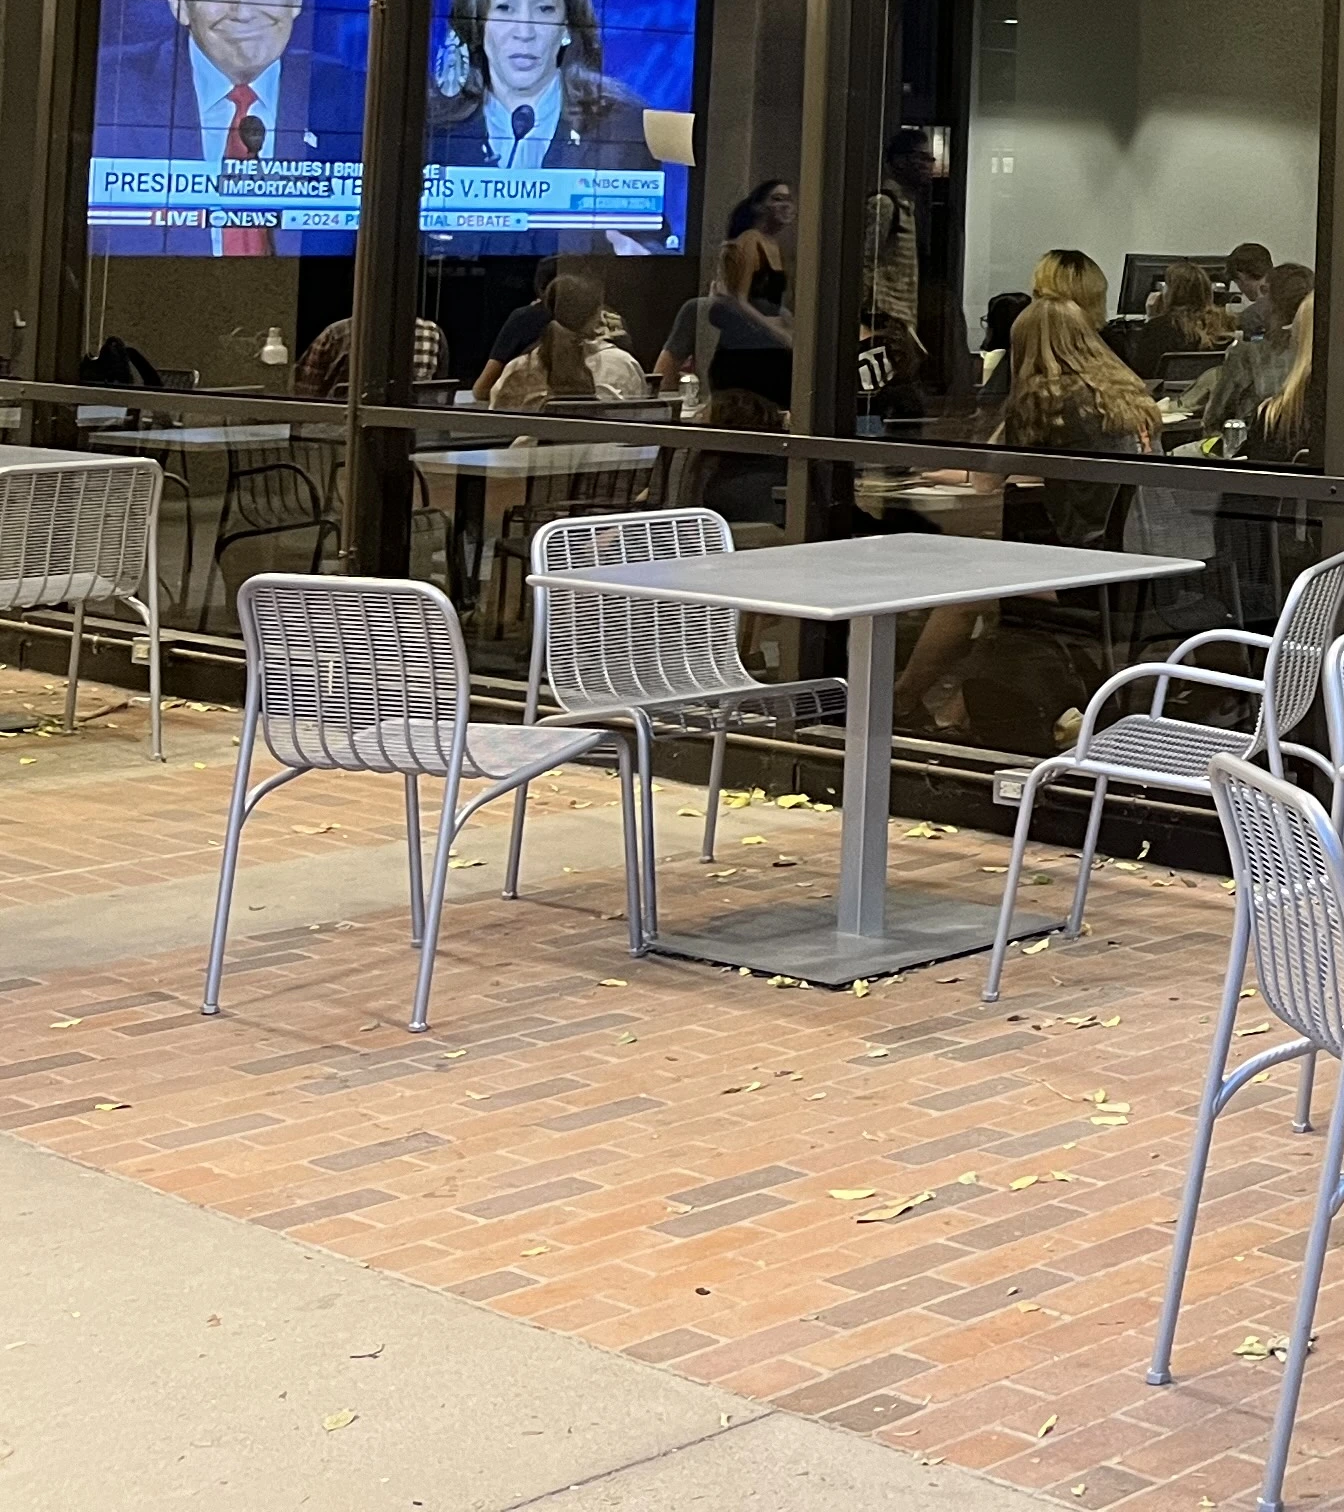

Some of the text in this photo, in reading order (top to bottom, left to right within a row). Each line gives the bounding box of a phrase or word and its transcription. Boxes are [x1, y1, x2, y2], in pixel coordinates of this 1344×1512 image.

[224, 159, 257, 175] THE
[262, 160, 322, 176] VALUES
[325, 161, 331, 177] I
[333, 161, 364, 177] BRI
[104, 171, 220, 194] PRESIDEN
[223, 179, 330, 196] IMPORTANCE
[592, 178, 660, 190] NBC NEWS
[155, 210, 199, 226] LIVE
[226, 211, 278, 227] NEWS
[302, 213, 340, 226] 2024
[456, 215, 511, 227] DEBATE
